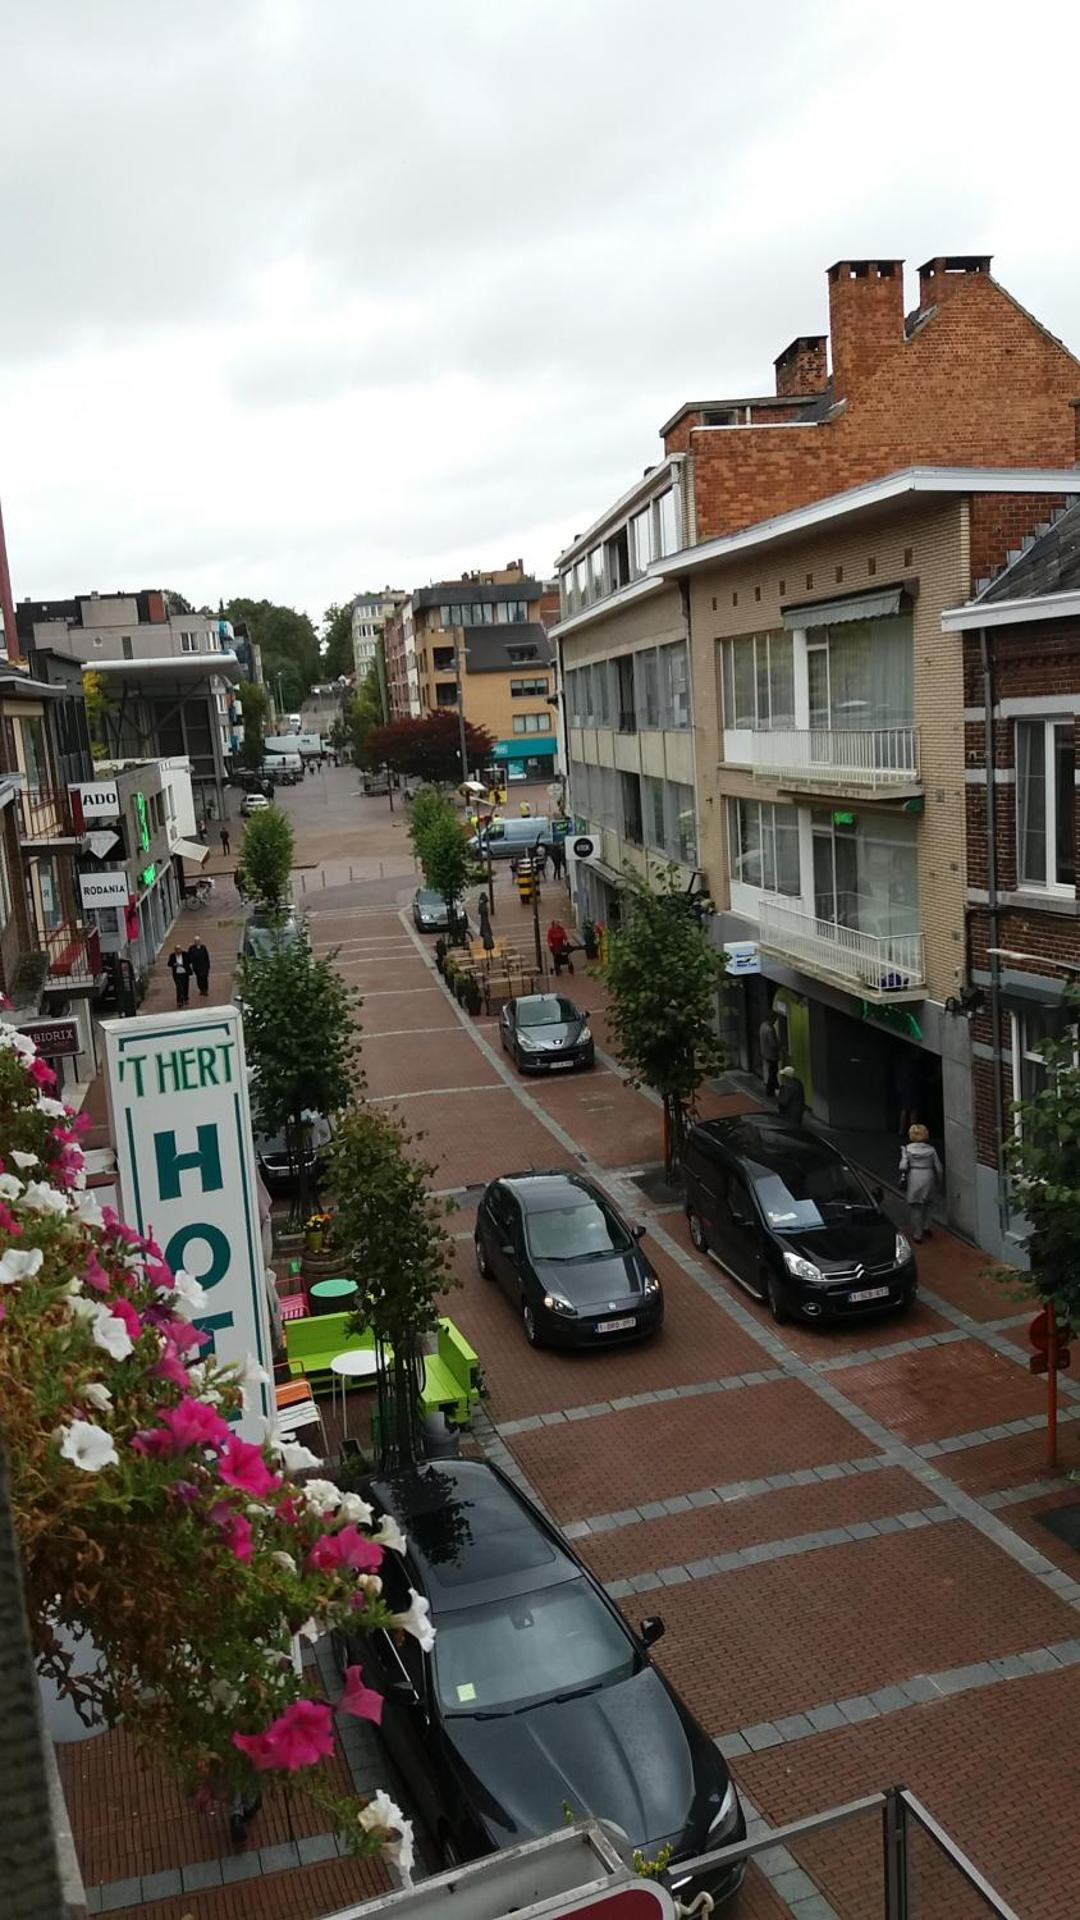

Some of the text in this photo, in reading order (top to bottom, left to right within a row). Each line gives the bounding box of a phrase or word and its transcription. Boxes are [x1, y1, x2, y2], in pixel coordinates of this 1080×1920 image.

[82, 792, 117, 806] ADO
[83, 884, 125, 897] RODANIA
[29, 1028, 73, 1043] BIORIX
[118, 1042, 235, 1098] 'T HERT
[154, 1123, 243, 1442] HOT
